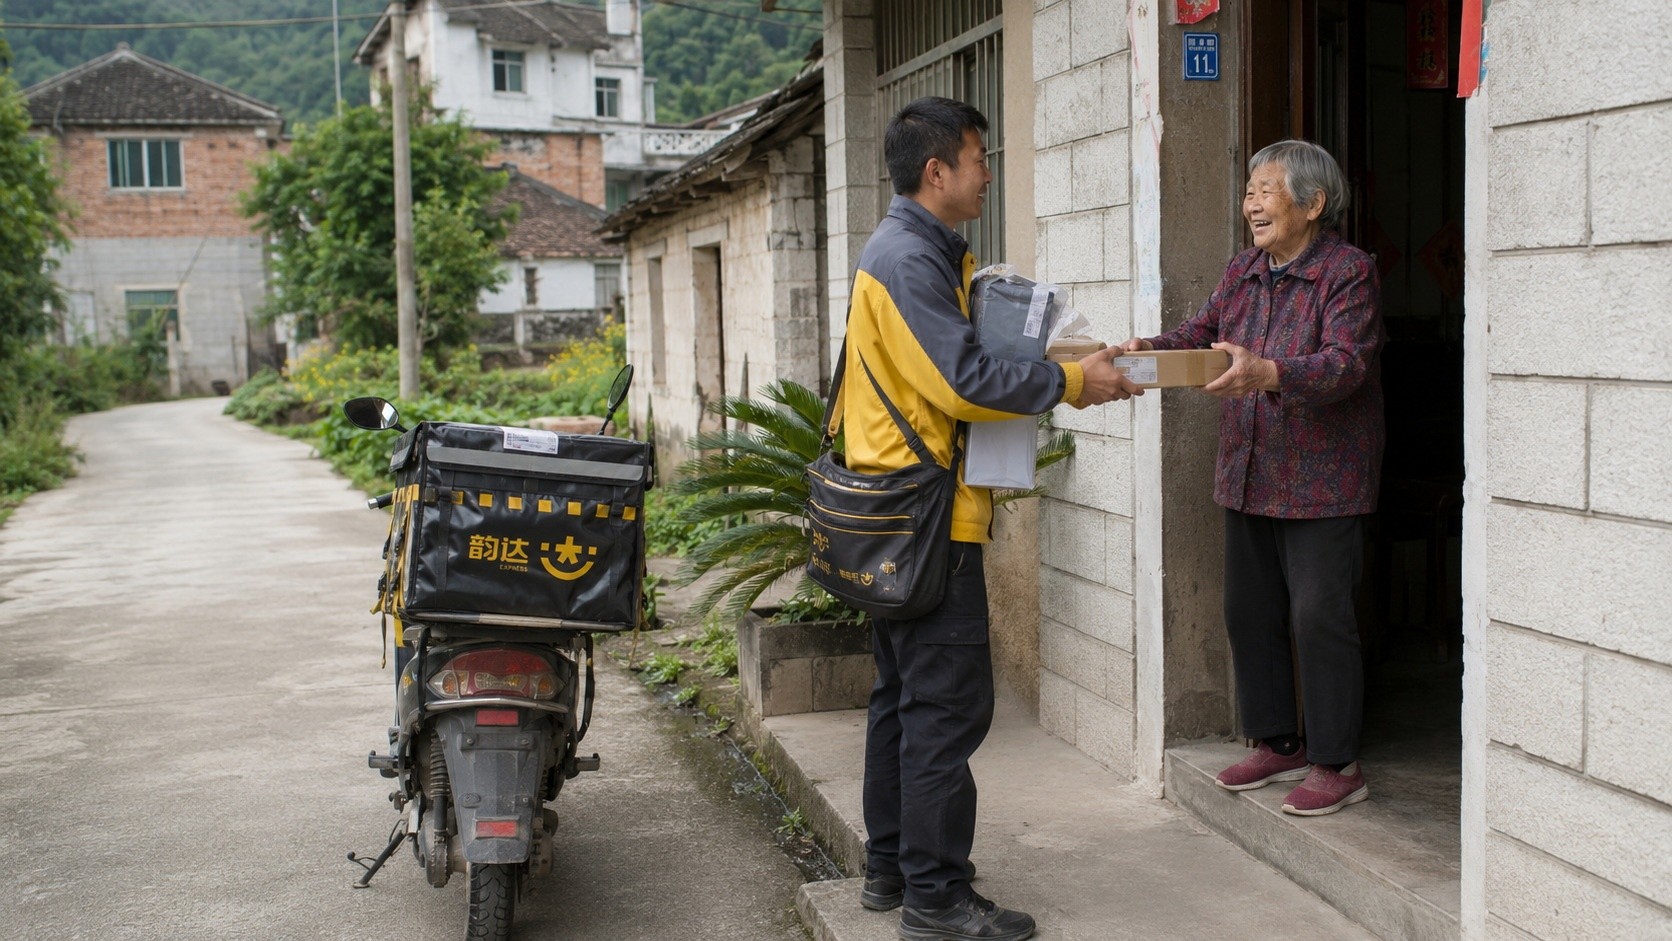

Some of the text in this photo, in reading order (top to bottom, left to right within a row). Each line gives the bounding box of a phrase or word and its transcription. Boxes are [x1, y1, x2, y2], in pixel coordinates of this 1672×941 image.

[1193, 53, 1208, 73] 11
[469, 534, 529, 564] 韵达
[499, 564, 528, 573] EXPRESS
